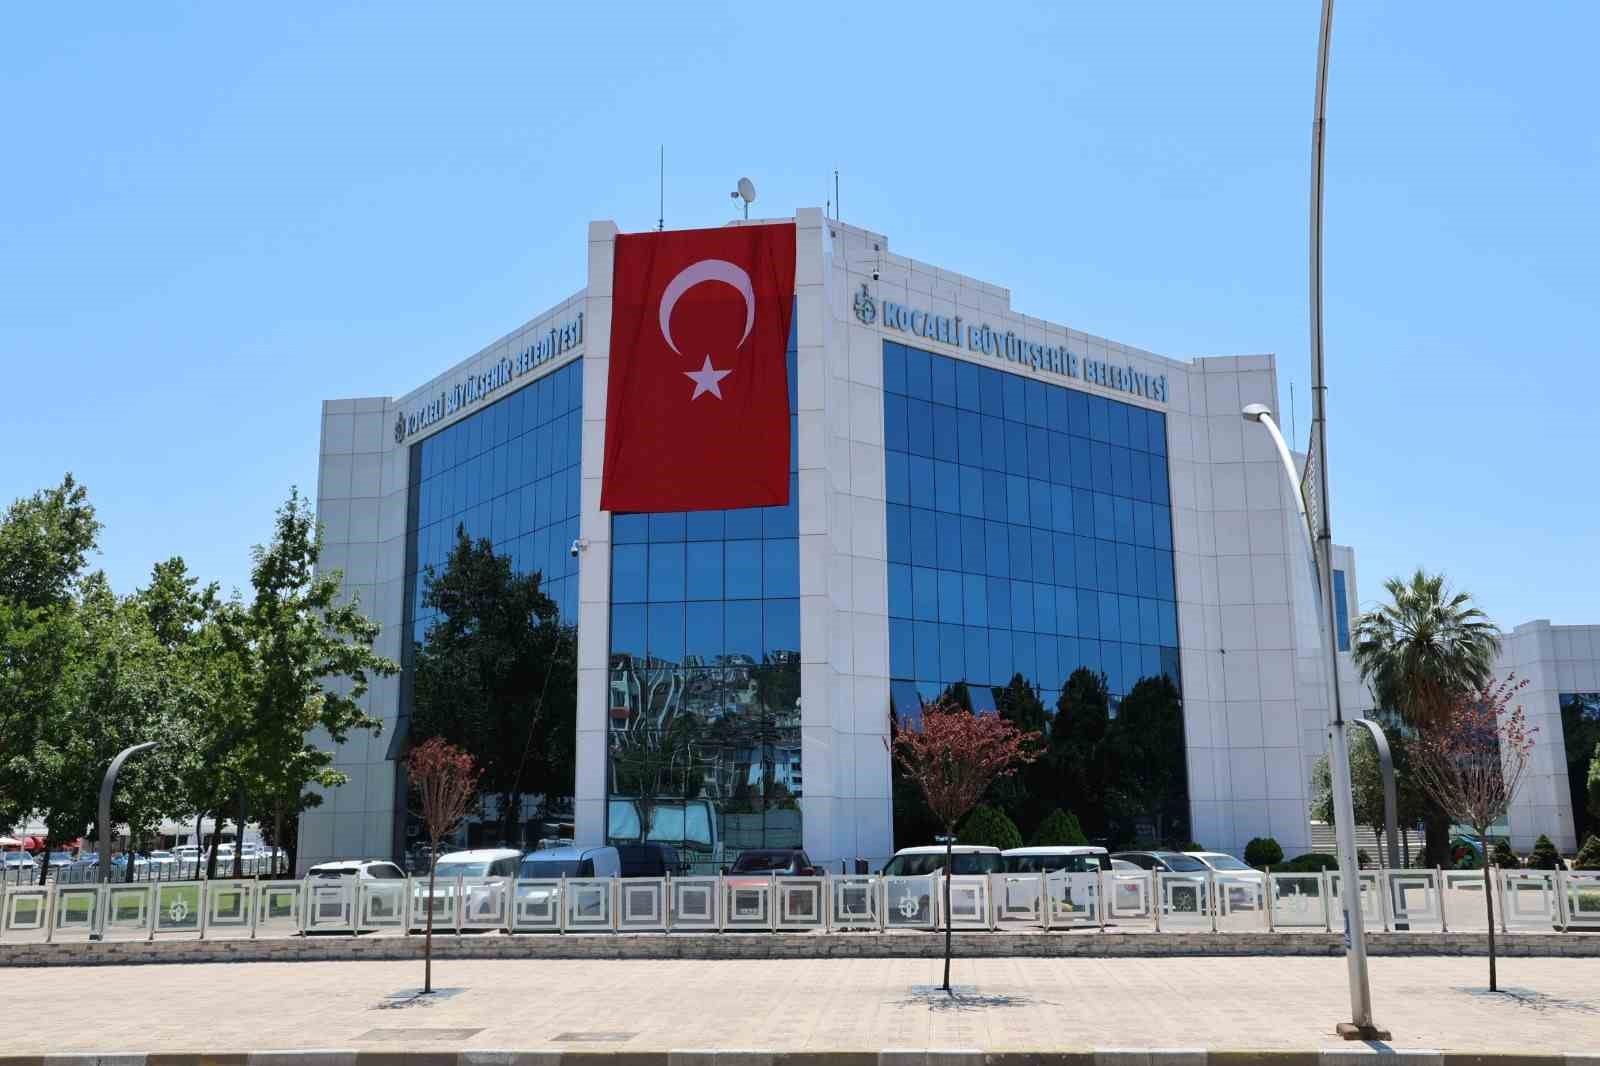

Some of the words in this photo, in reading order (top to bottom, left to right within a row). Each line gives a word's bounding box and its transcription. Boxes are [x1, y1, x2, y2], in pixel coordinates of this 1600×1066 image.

[882, 300, 964, 347] KOCAELİ
[968, 322, 1080, 378] BÜYÜKŞEHİR
[1083, 357, 1170, 403] BELEDİYESİ
